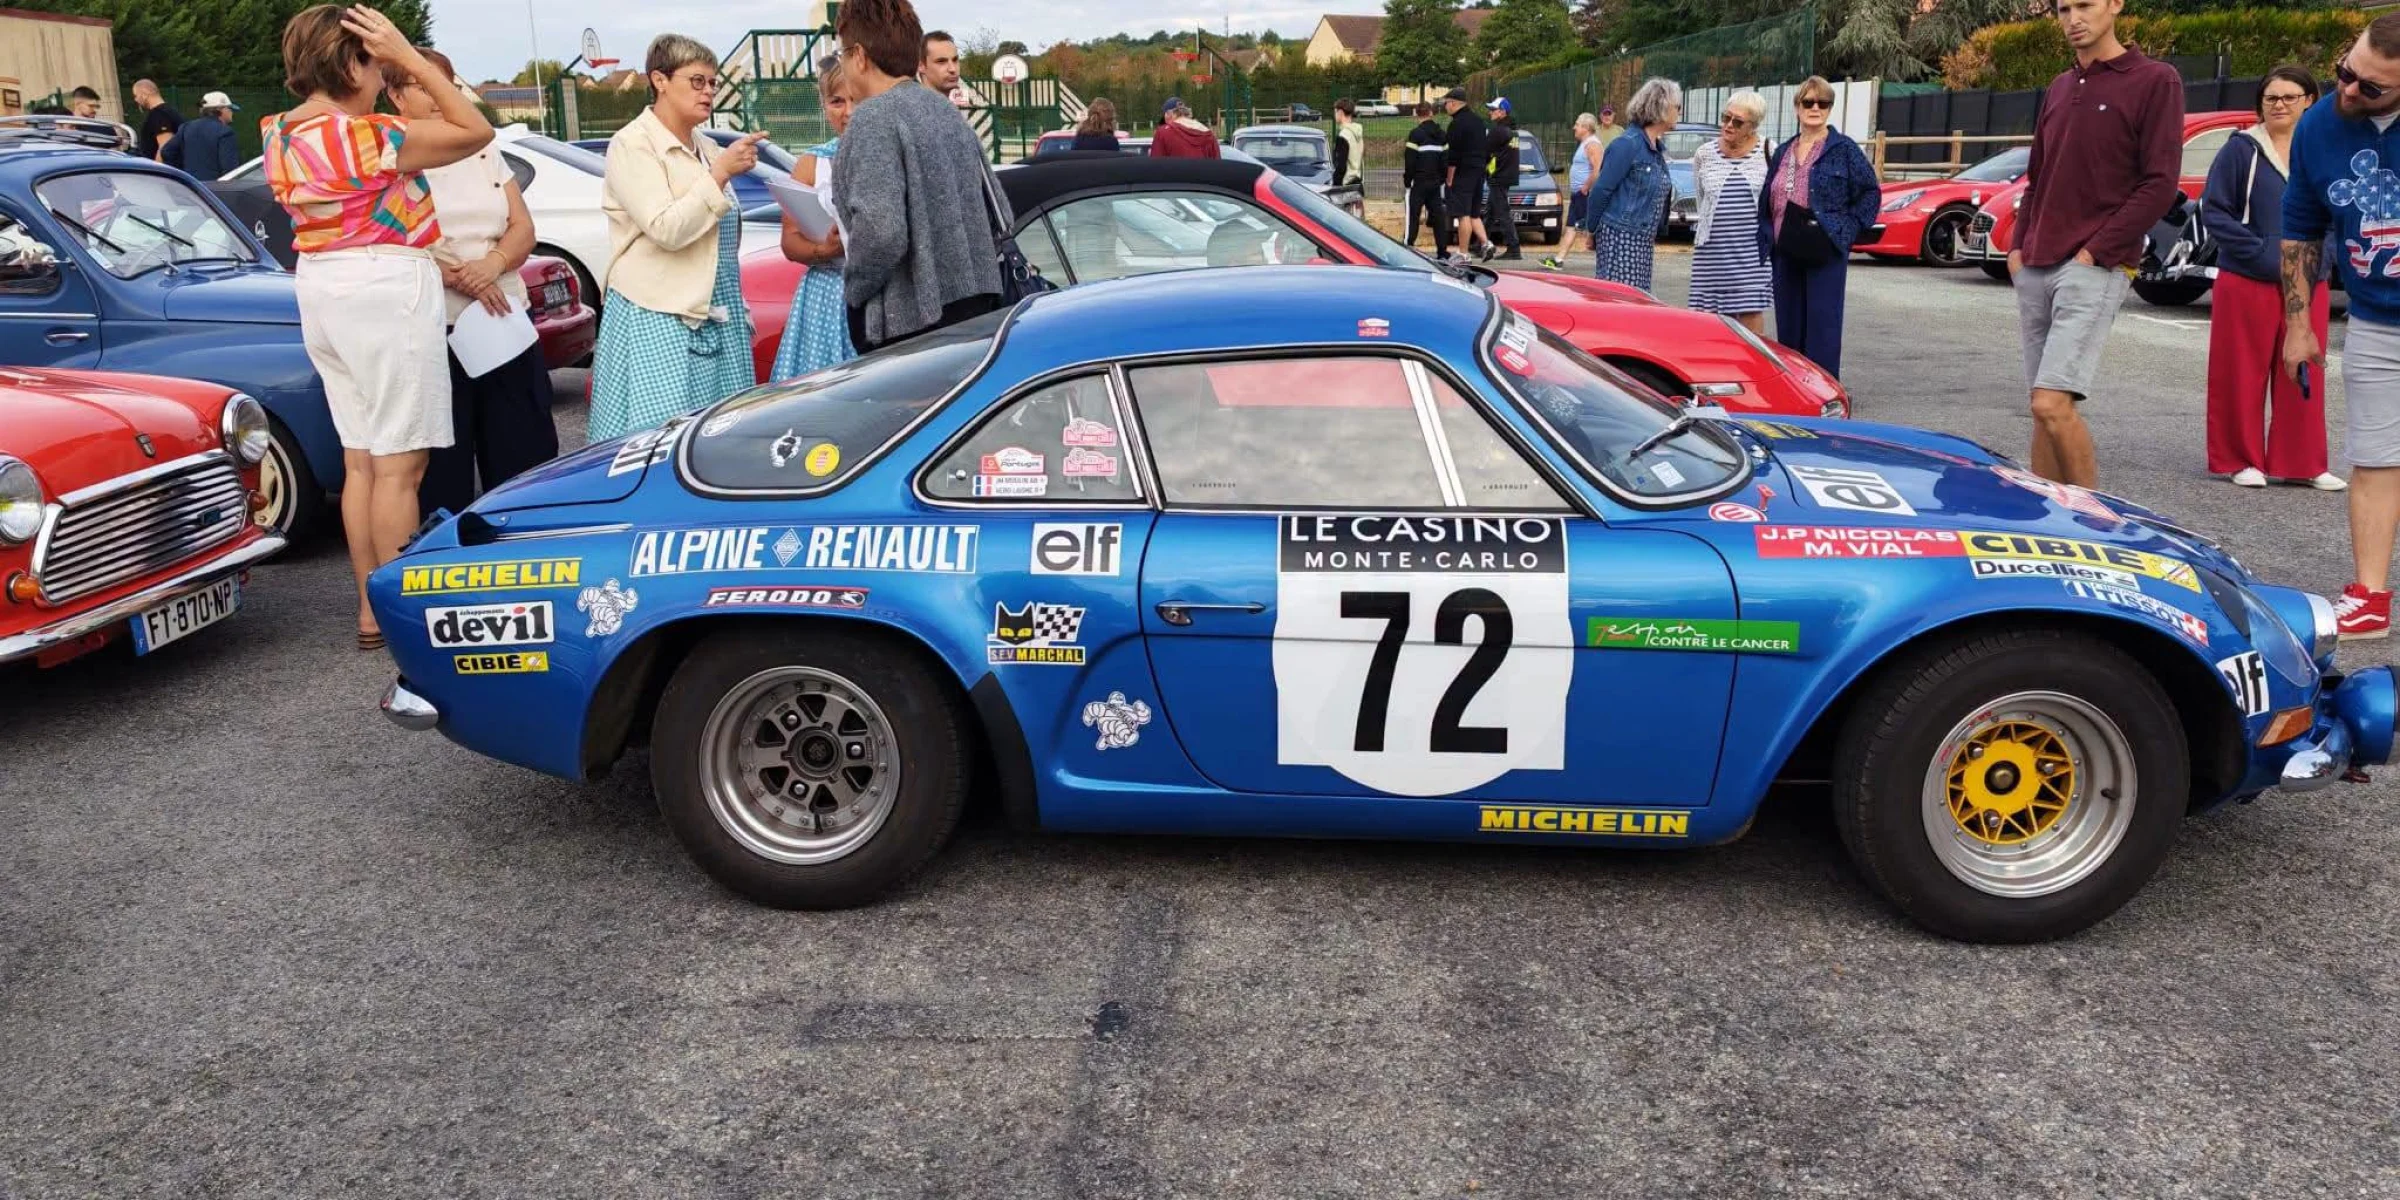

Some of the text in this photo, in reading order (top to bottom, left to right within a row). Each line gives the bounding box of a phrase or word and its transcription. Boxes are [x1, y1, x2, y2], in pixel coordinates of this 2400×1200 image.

[1291, 516, 1550, 543] LE CASINO
[1814, 531, 1957, 542] NICOLAS
[632, 528, 768, 575] ALPINE
[805, 526, 976, 571] RENAULT
[1037, 525, 1119, 572] elf
[1305, 551, 1538, 569] MONTE CARLO
[1803, 543, 1923, 556] M. VIAL
[402, 560, 581, 592] MICHELIN
[1975, 561, 2108, 580] Ducellier
[706, 590, 832, 606] FERODO
[2097, 588, 2186, 631] TISSOT
[433, 604, 548, 644] devil
[1016, 648, 1082, 662] MARCHAL
[1650, 636, 1708, 647] CONTRE
[1713, 638, 1727, 648] LE
[1731, 638, 1789, 650] CANCER
[1340, 587, 1514, 754] 72
[1481, 810, 1688, 834] MICHELIN
